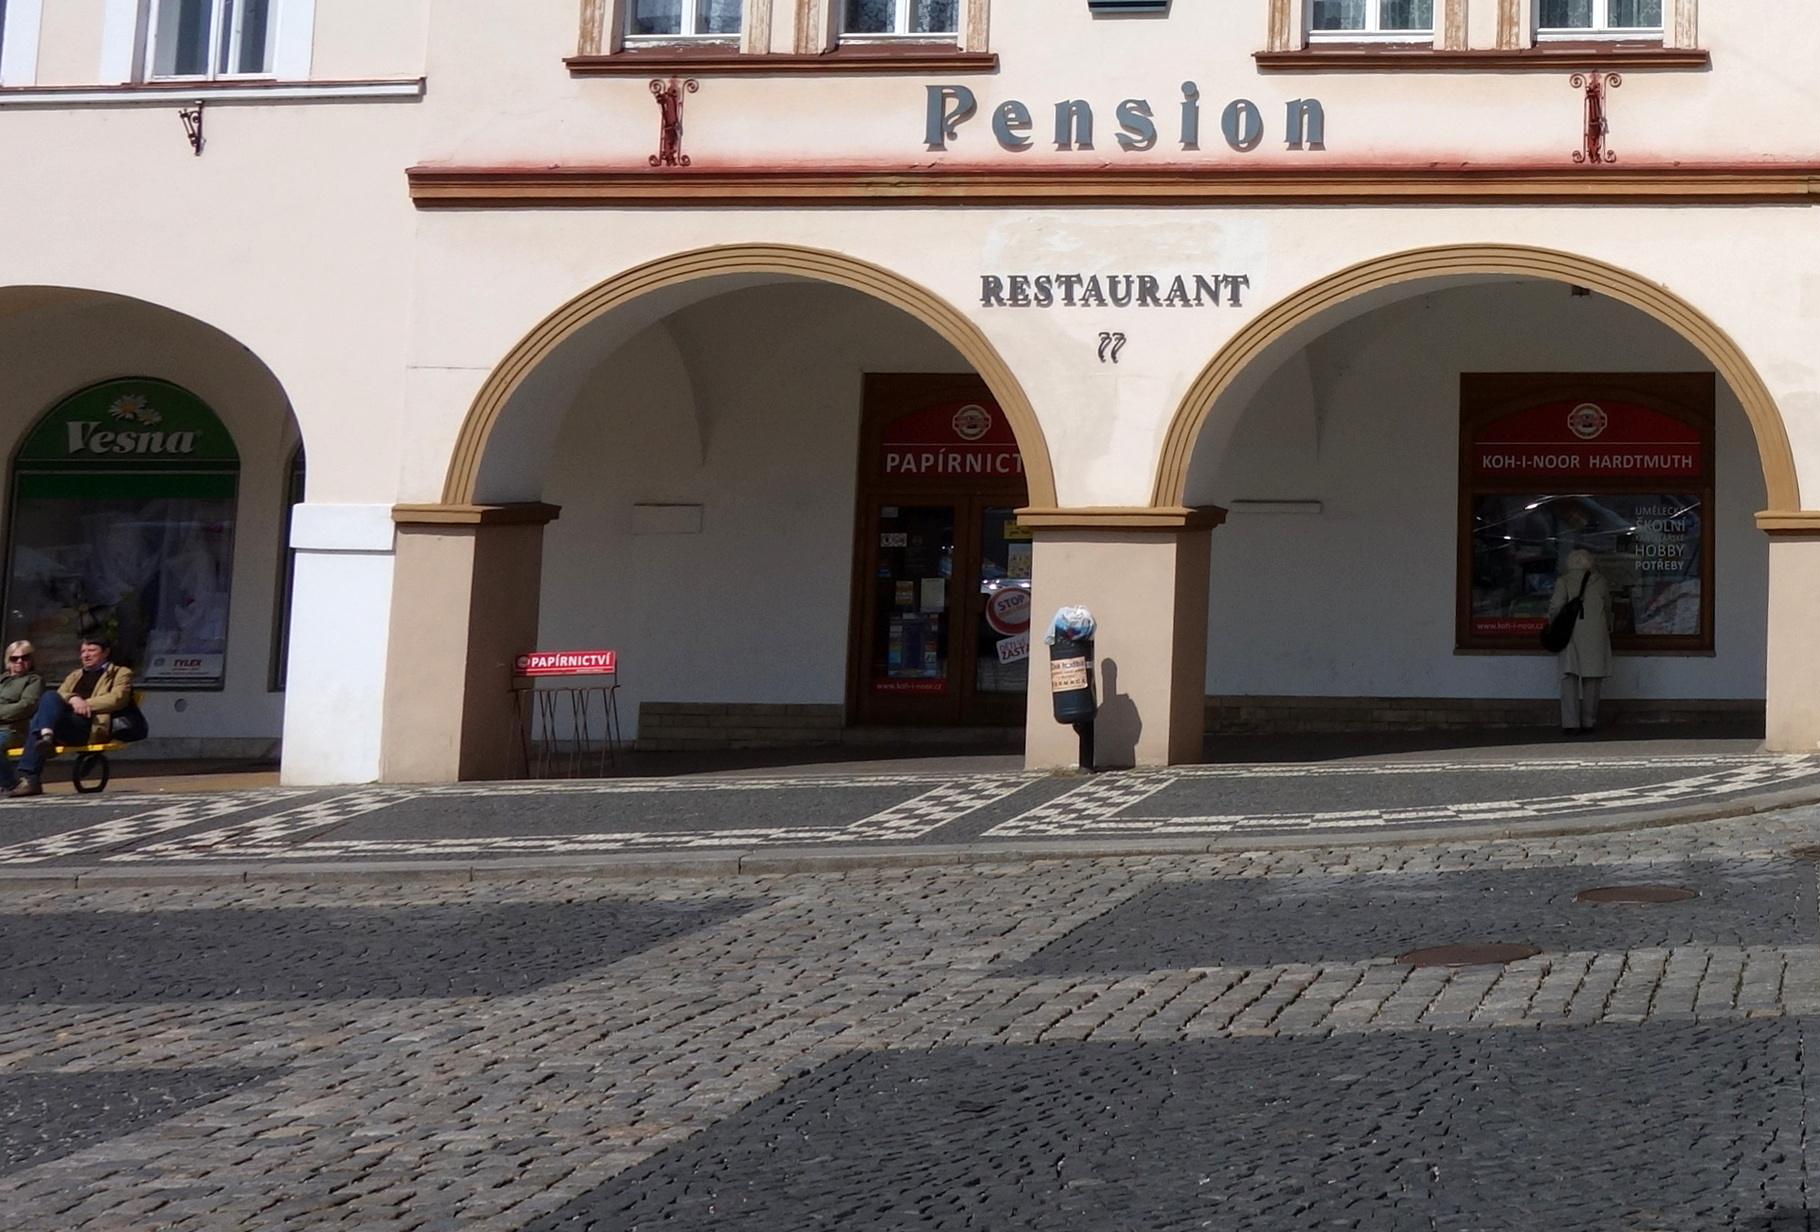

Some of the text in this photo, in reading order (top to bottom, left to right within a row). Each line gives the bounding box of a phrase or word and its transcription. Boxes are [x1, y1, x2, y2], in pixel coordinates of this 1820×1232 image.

[923, 80, 1326, 152] Pension
[979, 273, 1250, 308] RESTAURANT
[1097, 331, 1127, 364] 77
[65, 420, 197, 454] Vesna
[1482, 454, 1693, 469] KOH-I-NOOR HARDTMUTH
[1635, 544, 1685, 557] HOBBY
[1635, 558, 1685, 571] POTŘEBY
[997, 594, 1025, 612] STOP
[531, 652, 611, 668] PAPÍRNICTVÍ
